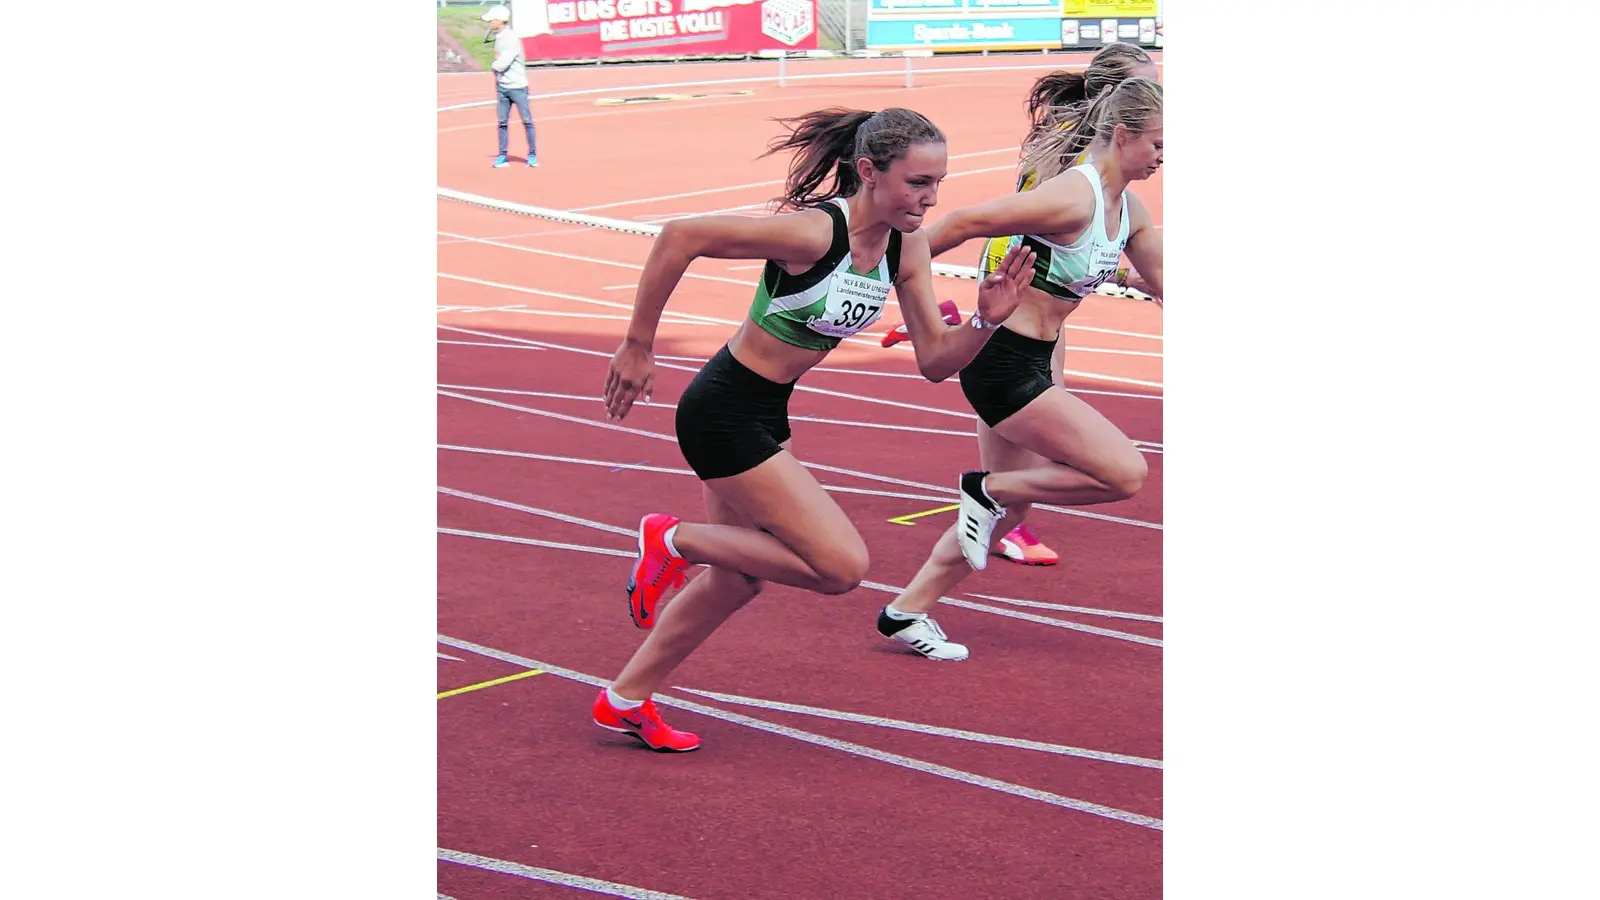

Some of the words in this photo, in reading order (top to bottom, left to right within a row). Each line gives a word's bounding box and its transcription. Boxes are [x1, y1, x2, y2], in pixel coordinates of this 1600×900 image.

[578, 0, 616, 20] UNS
[601, 20, 629, 41] DIE
[630, 16, 676, 38] KISTE
[676, 11, 722, 33] VOLL!
[843, 278, 854, 286] NLV
[833, 300, 880, 329] 397
